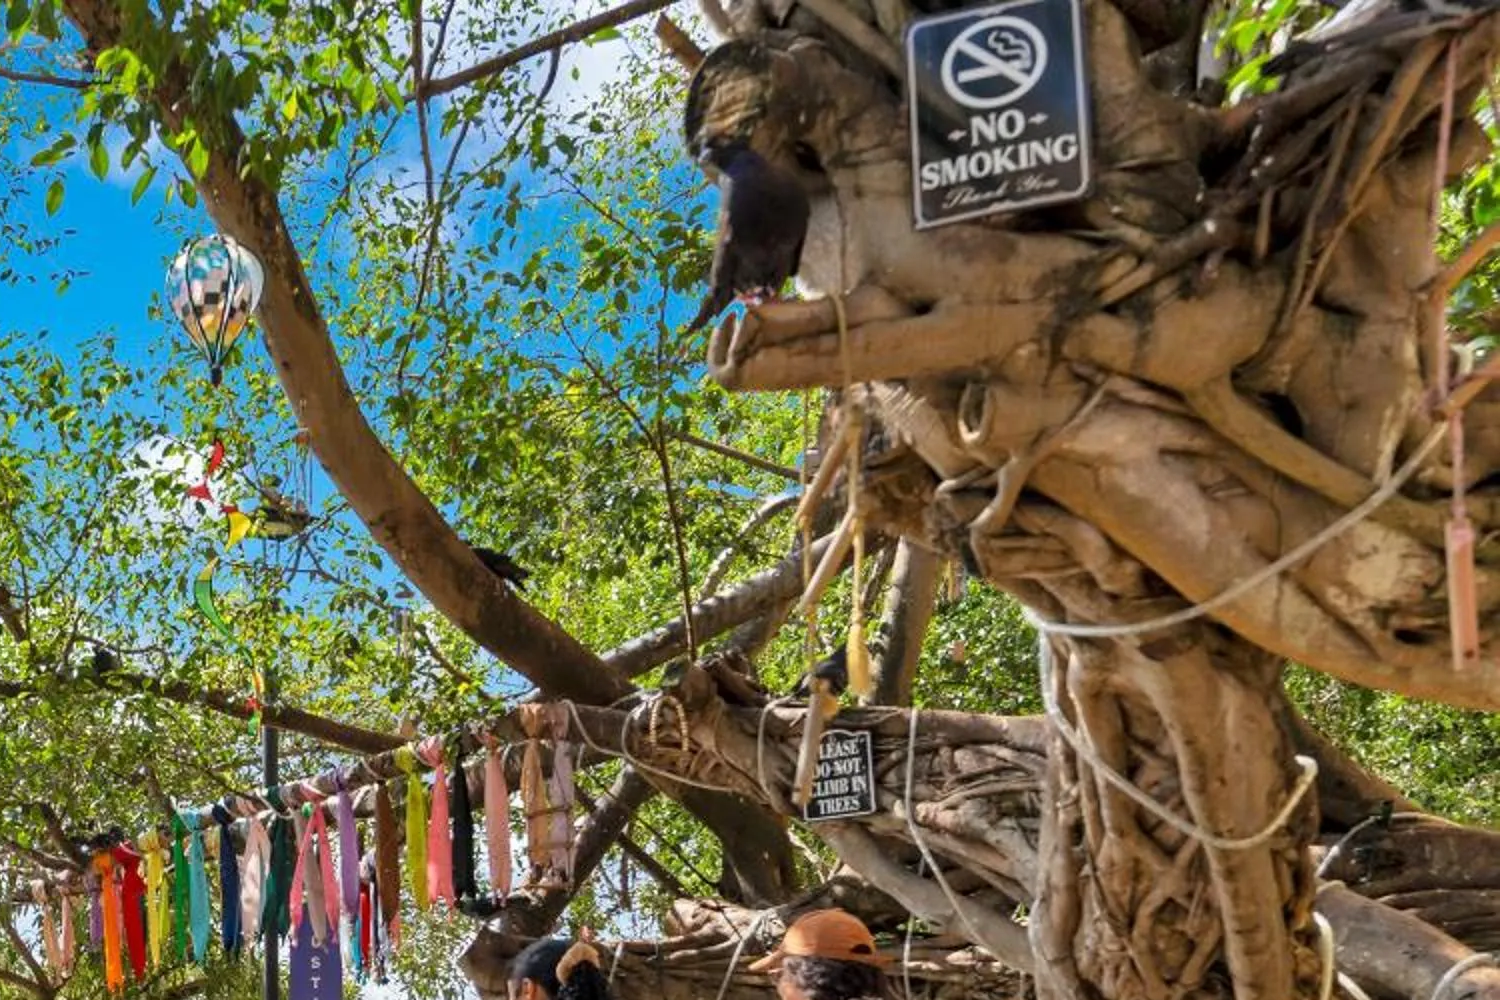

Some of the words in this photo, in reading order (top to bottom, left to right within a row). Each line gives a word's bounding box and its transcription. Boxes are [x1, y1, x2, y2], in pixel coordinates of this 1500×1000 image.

[970, 108, 1025, 147] NO
[921, 134, 1078, 191] SMOKING
[942, 179, 1009, 209] Thank
[819, 738, 860, 759] LEASE
[832, 757, 863, 777] NOT
[851, 775, 867, 794] IN
[818, 795, 861, 815] TREES
